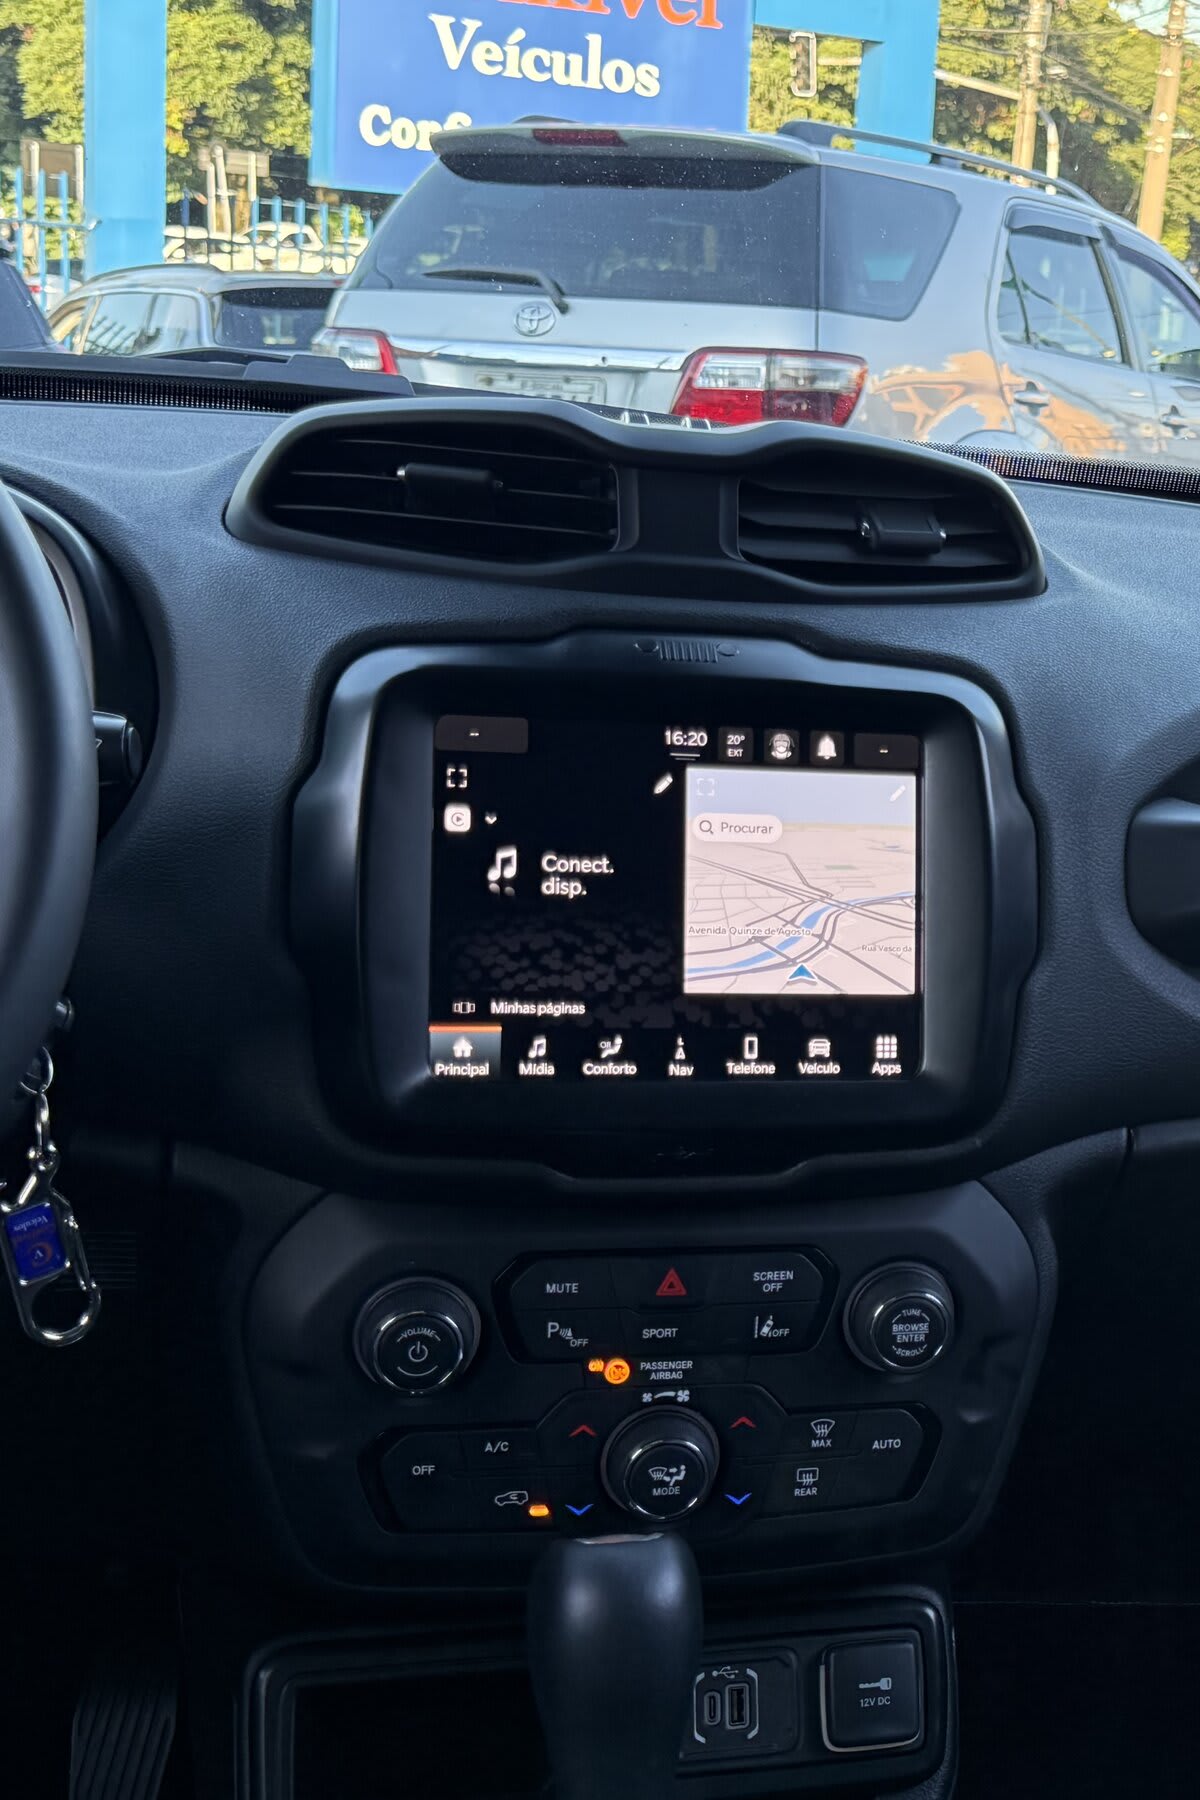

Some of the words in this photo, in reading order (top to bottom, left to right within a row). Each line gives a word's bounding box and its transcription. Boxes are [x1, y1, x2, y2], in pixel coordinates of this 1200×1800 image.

[427, 13, 661, 98] Veículos
[664, 730, 708, 746] 16:20
[727, 734, 745, 745] 20°
[728, 748, 743, 757] EXT
[720, 821, 773, 835] Procurar
[541, 853, 614, 873] Conect.
[541, 877, 587, 899] disp.
[688, 926, 727, 936] Avenida
[729, 926, 762, 936] Quinze
[777, 927, 811, 938] Agosto
[861, 944, 876, 952] Rua
[491, 1001, 536, 1015] Minhas
[537, 1001, 585, 1017] páginas
[435, 1062, 489, 1077] Principal
[519, 1062, 555, 1075] Mídia
[583, 1062, 637, 1075] Conforto
[668, 1062, 694, 1076] Nav
[726, 1062, 776, 1075] Telefone
[798, 1062, 841, 1075] Veículo
[872, 1062, 902, 1076] Apps
[753, 1270, 794, 1281] SCREEN
[546, 1283, 579, 1293] MUTE
[763, 1283, 783, 1292] OFF
[902, 1308, 922, 1317] TUNE
[401, 1327, 437, 1339] VOLUME
[772, 1328, 790, 1337] OFF
[892, 1323, 929, 1332] BROWSE
[642, 1328, 678, 1339] SPORT
[897, 1334, 925, 1342] ENTER
[570, 1338, 589, 1347] OFF
[895, 1347, 924, 1357] SCROLL
[640, 1361, 693, 1370] PASSENGER
[650, 1371, 683, 1380] AIRBAG
[484, 1441, 509, 1453] A/C
[811, 1439, 832, 1448] MAX
[872, 1439, 902, 1450] AUTO
[412, 1465, 435, 1475] OFF
[652, 1486, 681, 1496] MODE
[794, 1487, 818, 1496] REAR
[860, 1697, 876, 1708] 12V
[877, 1696, 891, 1706] DC
